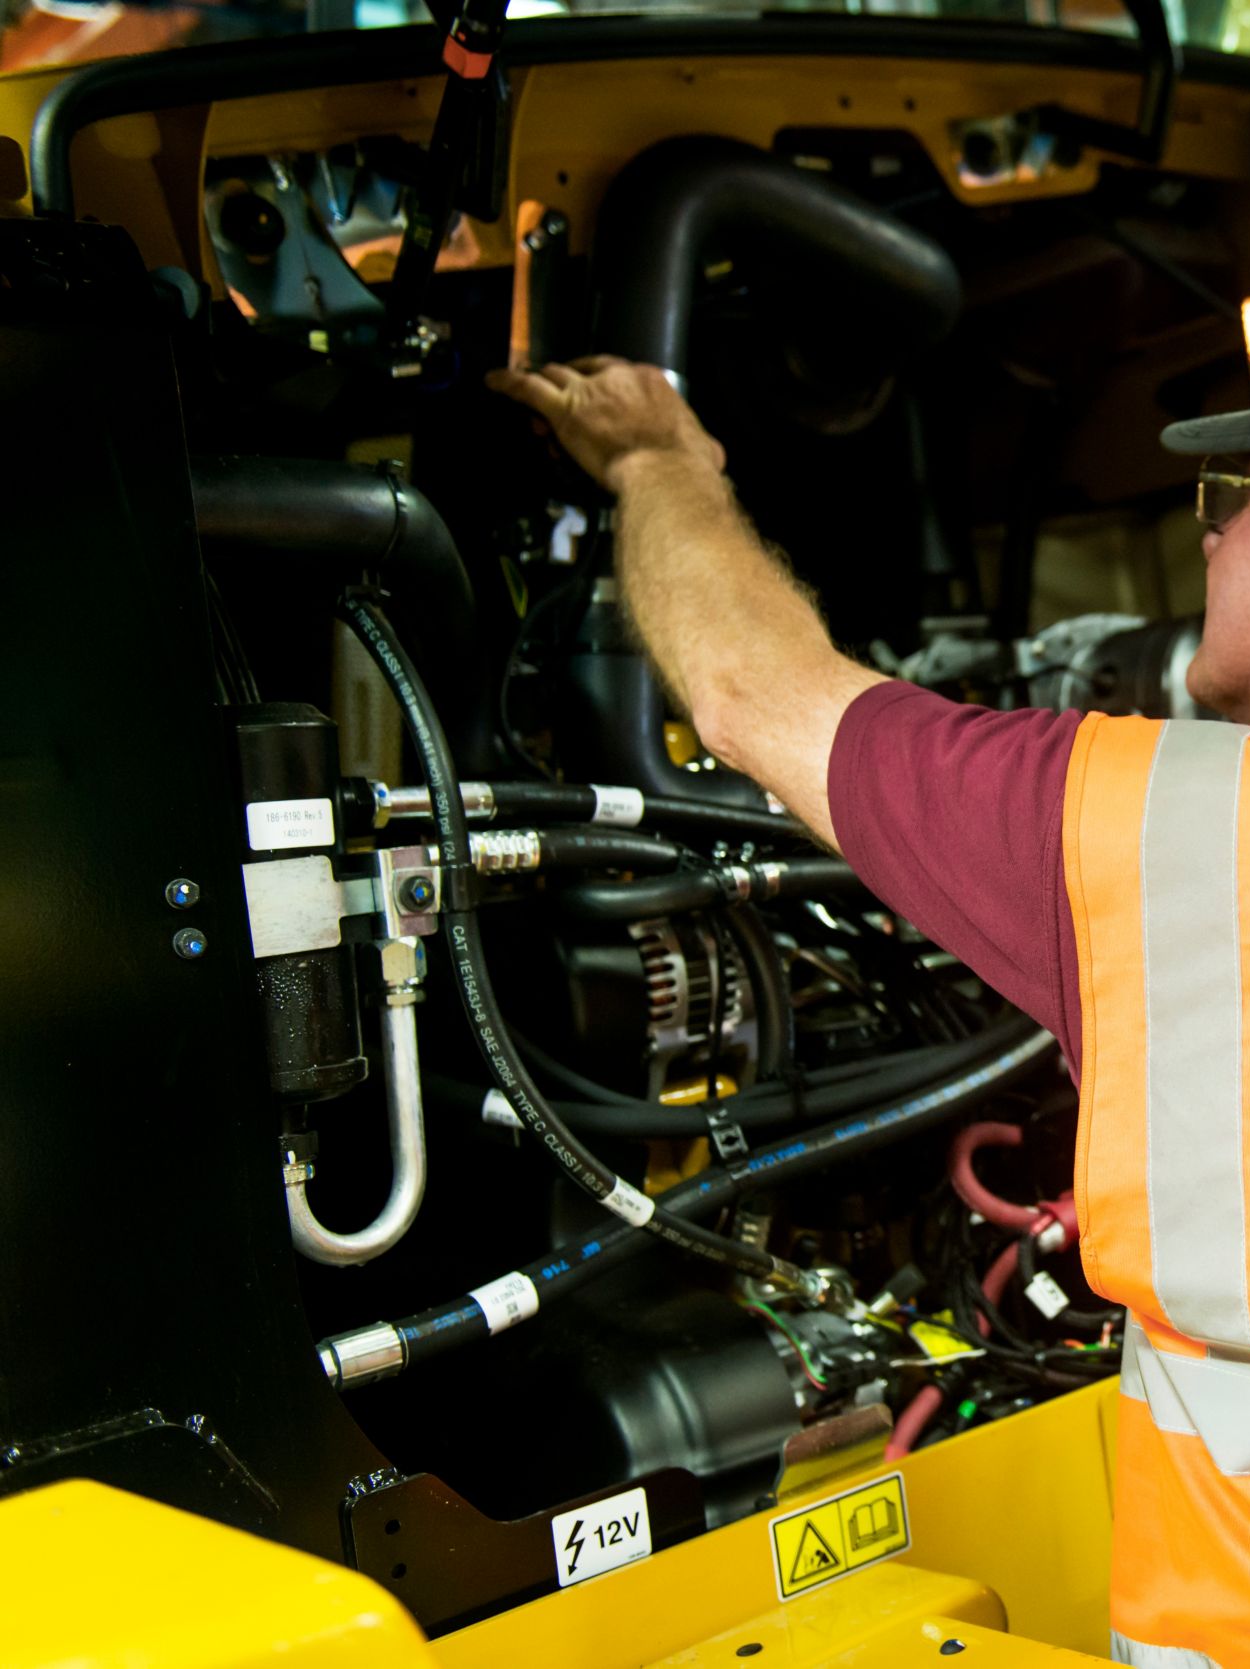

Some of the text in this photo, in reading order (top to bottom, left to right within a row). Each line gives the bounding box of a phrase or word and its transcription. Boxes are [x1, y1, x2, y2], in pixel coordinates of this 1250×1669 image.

[452, 925, 468, 952] CAT
[480, 1027, 500, 1053] SAE
[492, 1056, 517, 1087] J2064
[513, 1089, 540, 1122] TYPE
[534, 1121, 546, 1132] C
[544, 1134, 577, 1168] CLASS
[593, 1511, 640, 1549] 12V
